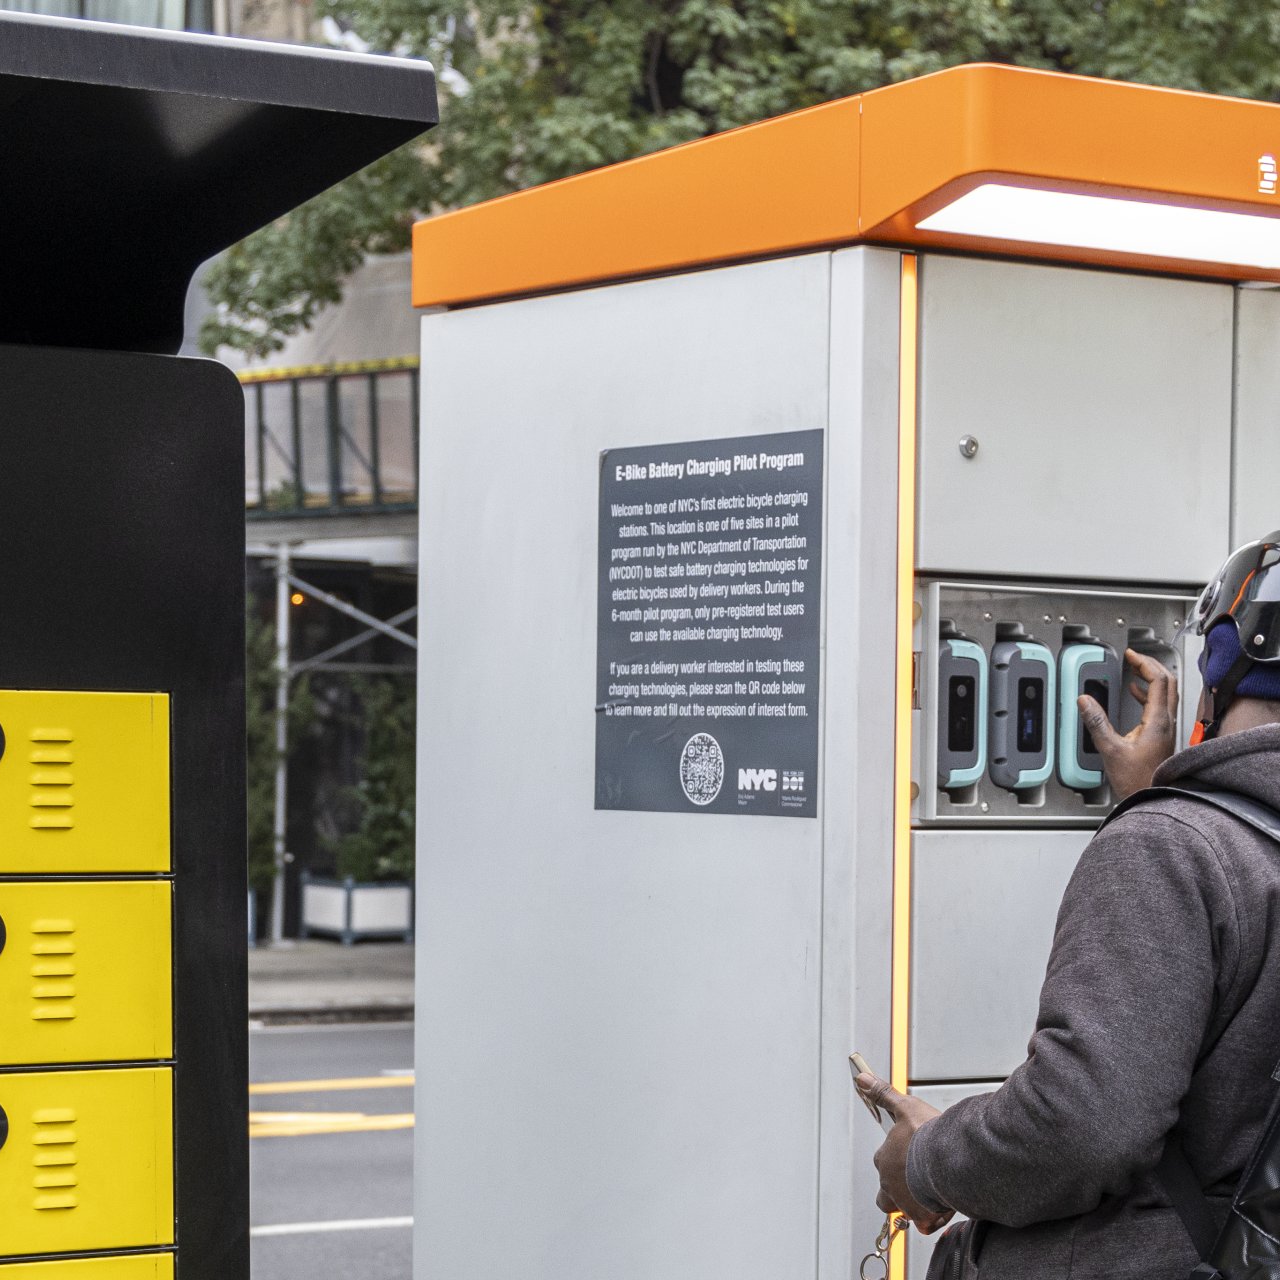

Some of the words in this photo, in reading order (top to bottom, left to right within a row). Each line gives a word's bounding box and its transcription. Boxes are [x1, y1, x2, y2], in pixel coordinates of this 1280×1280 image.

[615, 464, 647, 481] E-Bike
[648, 461, 684, 478] Battery
[686, 458, 731, 476] Charging
[733, 455, 757, 471] Pilot
[759, 452, 804, 471] Program
[610, 503, 644, 517] Welcome
[644, 502, 652, 515] to
[653, 502, 668, 514] one
[668, 499, 677, 513] of
[700, 497, 716, 510] first
[716, 495, 745, 510] electric
[746, 493, 773, 510] bicycle
[774, 491, 808, 507] charging
[618, 523, 649, 538] stations.
[649, 522, 666, 535] This
[666, 520, 696, 534] location
[697, 519, 704, 533] is
[705, 520, 720, 532] one
[720, 517, 729, 531] of
[730, 516, 744, 530] five
[745, 515, 764, 530] sites
[765, 514, 773, 528] in
[781, 512, 799, 529] pilot
[611, 546, 641, 561] program
[642, 546, 655, 557] run
[656, 543, 666, 559] by
[666, 542, 679, 556] the
[680, 541, 697, 555] NYC
[697, 538, 742, 556] Department
[742, 538, 751, 552] of
[751, 535, 807, 552] Transportation
[609, 565, 643, 582] (NYCDOT)
[644, 565, 652, 578] to
[653, 564, 668, 578] test
[668, 563, 685, 577] safe
[685, 562, 712, 578] battery
[713, 560, 746, 577] charging
[747, 557, 796, 574] technologies
[797, 556, 809, 570] for
[611, 586, 638, 601] electric
[639, 585, 668, 601] bicycles
[669, 584, 688, 598] used
[688, 584, 698, 600] by
[699, 583, 729, 598] delivery
[730, 581, 763, 595] workers.
[764, 580, 790, 596] During
[791, 579, 805, 593] the
[611, 607, 642, 622] 6-month
[643, 607, 659, 623] pilot
[660, 608, 693, 622] program,
[694, 605, 710, 621] only
[711, 603, 765, 620] pre-registered
[766, 603, 782, 616] test
[782, 603, 804, 616] users
[629, 631, 643, 642] can
[644, 630, 658, 642] use
[659, 628, 671, 641] the
[672, 627, 705, 641] available
[706, 626, 739, 642] charging
[740, 625, 783, 641] technology.
[610, 661, 616, 675] If
[616, 664, 630, 677] you
[630, 663, 643, 675] are
[650, 661, 679, 677] delivery
[680, 660, 706, 674] worker
[707, 660, 745, 673] interested
[746, 660, 754, 672] in
[755, 659, 781, 675] testing
[782, 659, 805, 672] these
[608, 683, 639, 698] charging
[640, 682, 688, 698] technologies,
[689, 682, 714, 697] please
[714, 683, 733, 695] scan
[734, 681, 747, 694] the
[748, 681, 760, 695] QR
[761, 680, 780, 694] code
[781, 680, 805, 694] below
[613, 703, 632, 716] learn
[633, 705, 652, 716] more
[653, 703, 667, 716] and
[668, 703, 678, 716] fill
[678, 703, 692, 716] out
[692, 703, 705, 716] the
[706, 703, 746, 719] expression
[747, 703, 756, 716] of
[757, 703, 786, 716] interest
[787, 703, 808, 717] form.
[738, 768, 777, 791] NYC
[782, 776, 804, 790] DOT
